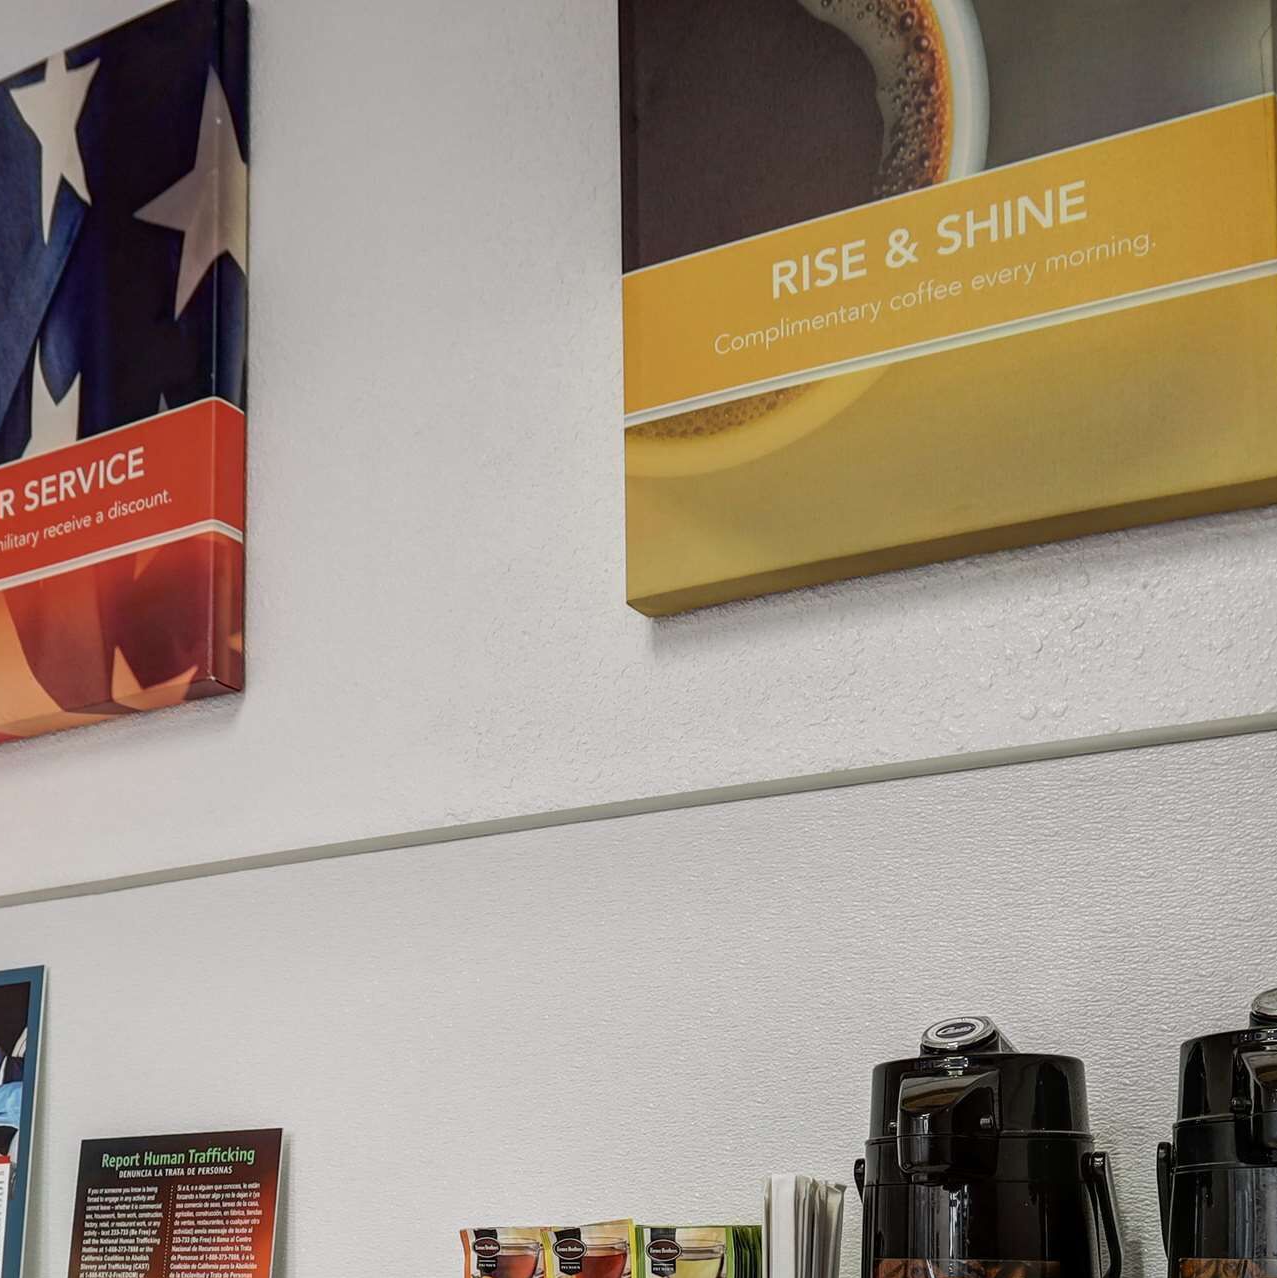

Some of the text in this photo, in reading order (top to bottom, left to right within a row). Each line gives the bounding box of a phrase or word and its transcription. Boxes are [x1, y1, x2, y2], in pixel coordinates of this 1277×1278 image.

[771, 180, 1088, 300] RISE & SHINE
[714, 231, 1156, 357] Complimentary coffee every morning.
[23, 446, 145, 512] SERVICE
[43, 514, 92, 541] receive
[95, 511, 105, 524] a
[108, 488, 172, 521] discount.
[102, 1146, 255, 1170] Report Human Trafficking
[118, 1165, 233, 1178] DENUNCIA LA TRATA DE PERSONAS
